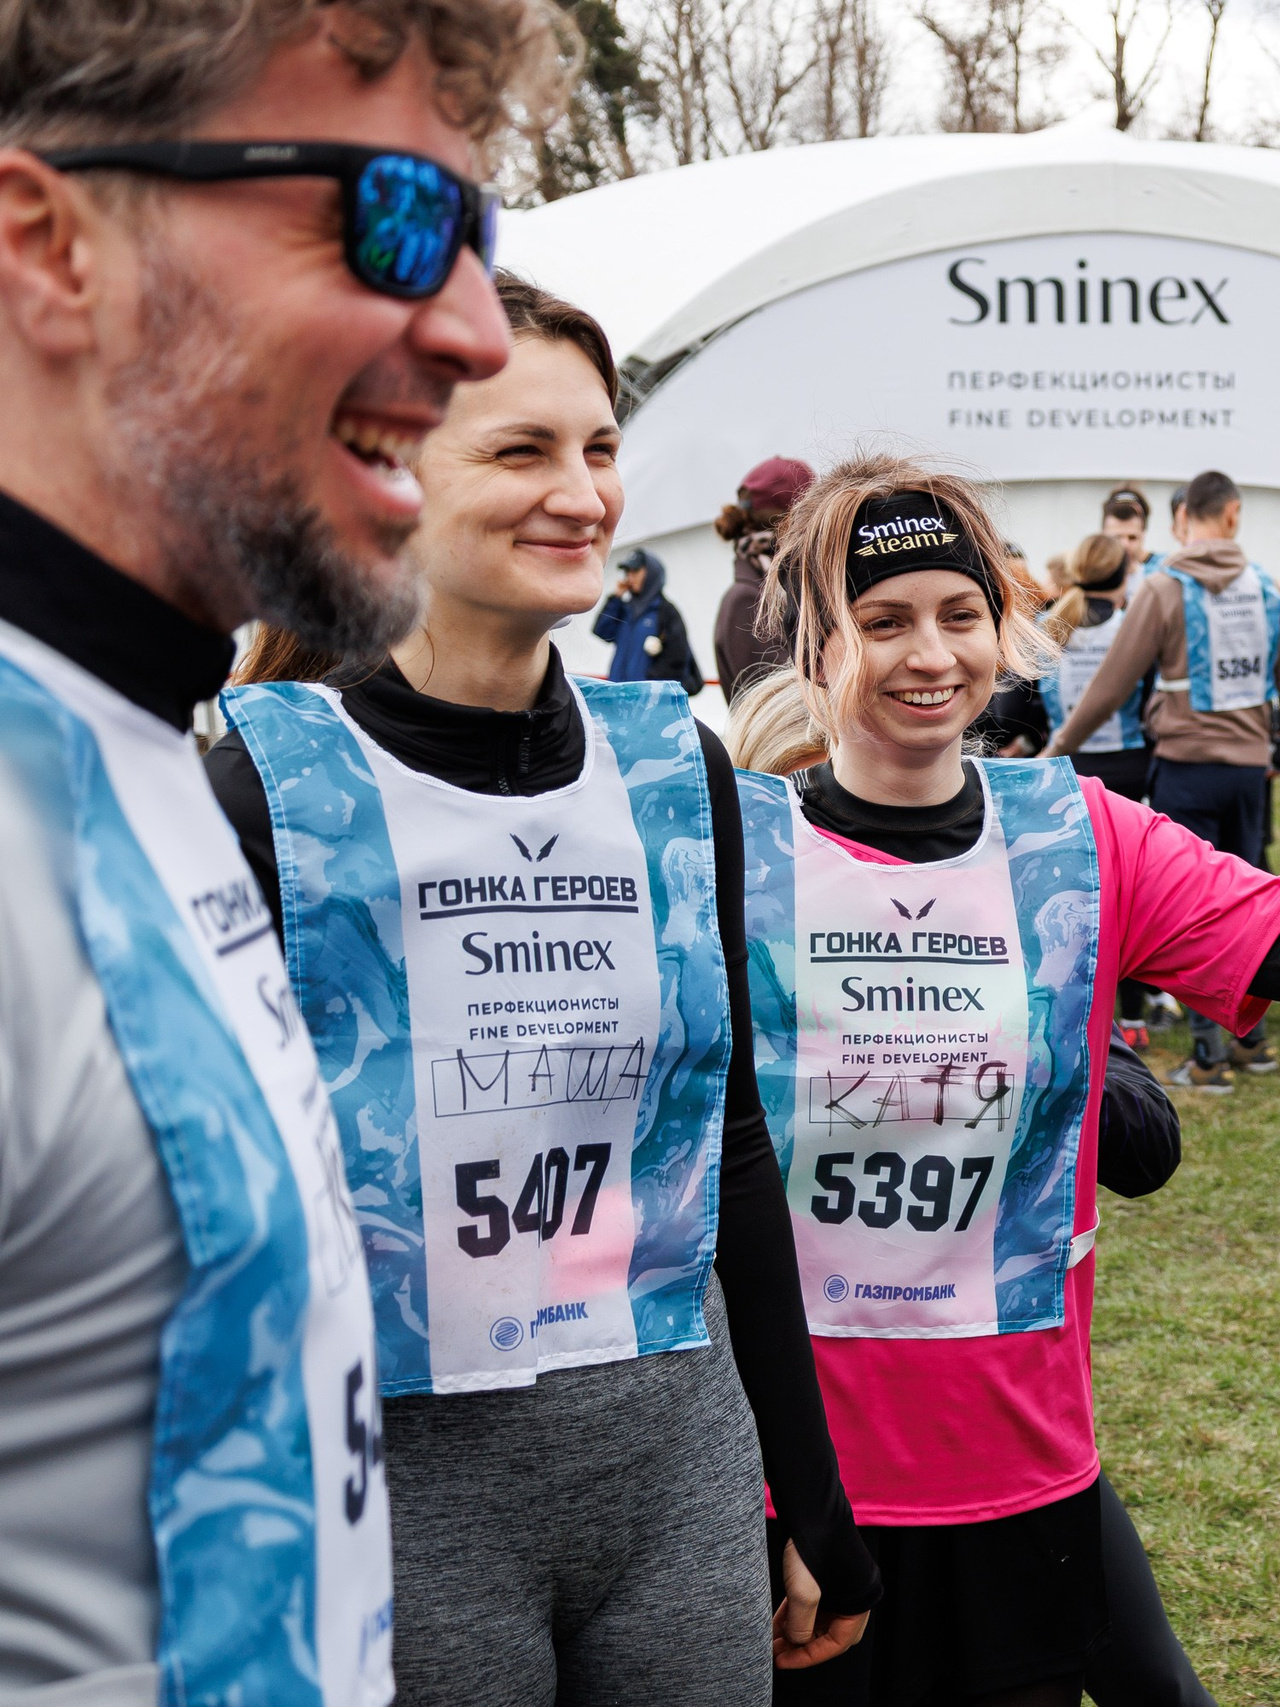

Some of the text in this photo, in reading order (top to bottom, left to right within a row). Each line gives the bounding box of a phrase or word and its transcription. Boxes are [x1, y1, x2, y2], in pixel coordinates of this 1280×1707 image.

[948, 257, 1230, 326] Sminex
[948, 371, 1236, 392] ПЕРФЕКЦИОНИСТЫ
[949, 409, 1234, 428] FINE DEVELOPMENT
[859, 516, 947, 543] Sminex
[877, 533, 939, 554] team
[418, 875, 637, 908] ГОНКА ГЕРОЕВ
[462, 930, 616, 976] Sminex
[810, 931, 1008, 956] ГОНКА ГЕРОЕВ
[467, 998, 619, 1016] ПЕРФЕКЦИОНИСТЫ
[841, 976, 985, 1012] Sminex
[469, 1021, 619, 1041] FINE DEVELOPMENT
[842, 1033, 989, 1046] ПЕРФЕКЦИОНИСТЫ
[842, 1052, 988, 1065] FINE DEVELOPMENT
[457, 1036, 649, 1114] МАША
[825, 1060, 1011, 1137] КАТЯ
[455, 1142, 612, 1258] 5407
[811, 1151, 995, 1232] 5397
[854, 1283, 956, 1301] ГАЗПРОМБАНК
